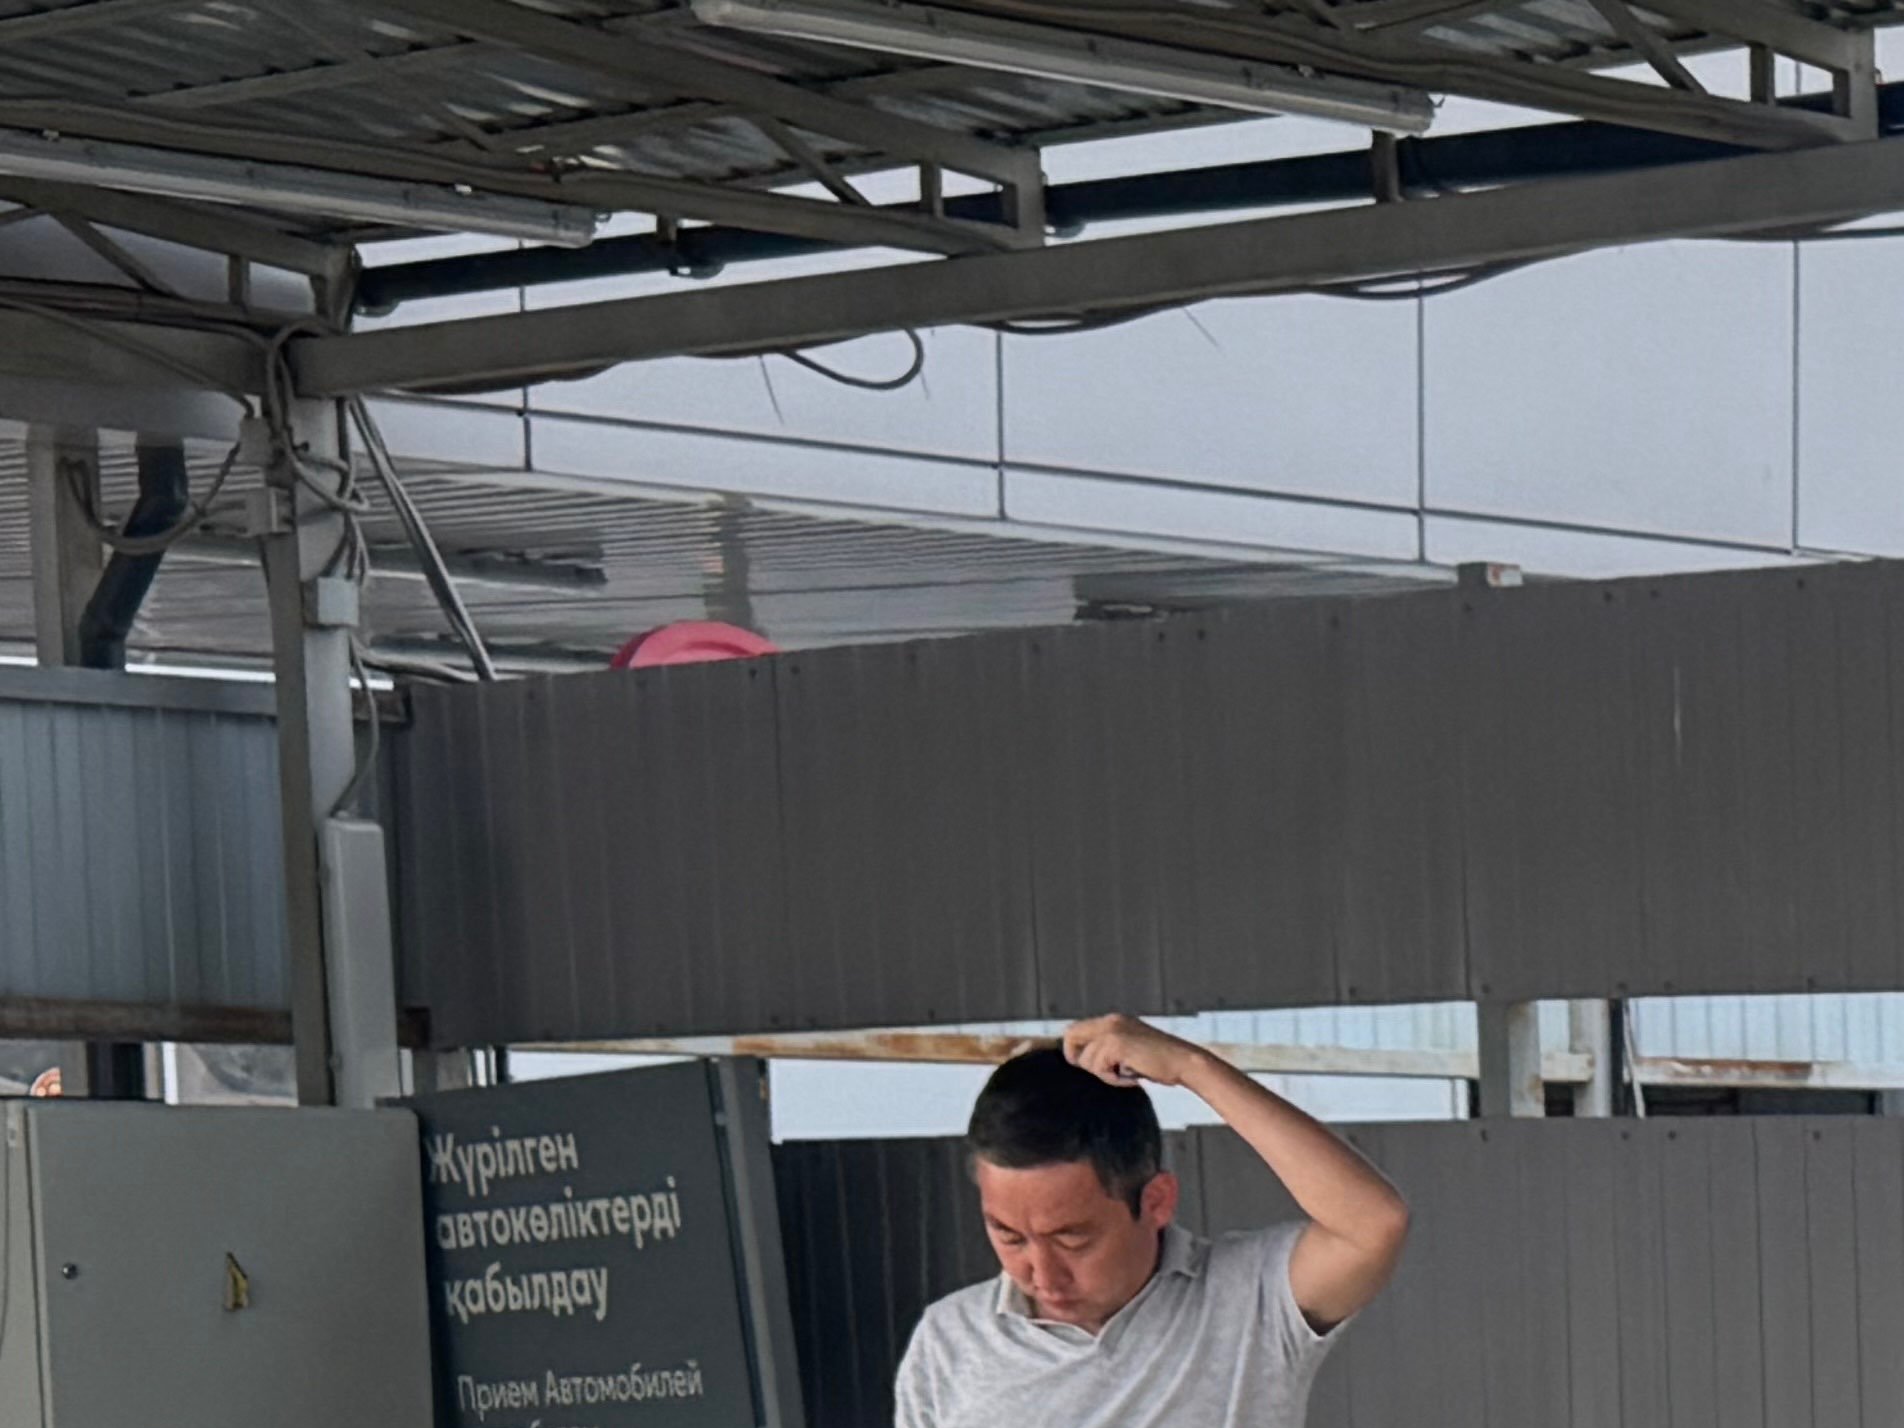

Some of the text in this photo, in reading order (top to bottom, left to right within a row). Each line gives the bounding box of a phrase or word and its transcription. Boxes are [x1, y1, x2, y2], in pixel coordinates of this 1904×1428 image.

[426, 1125, 579, 1197] Жүрілген
[437, 1176, 681, 1250] автокөліктерді
[445, 1262, 608, 1324] қабылдау
[457, 1360, 703, 1421] Прием Автомобилей
